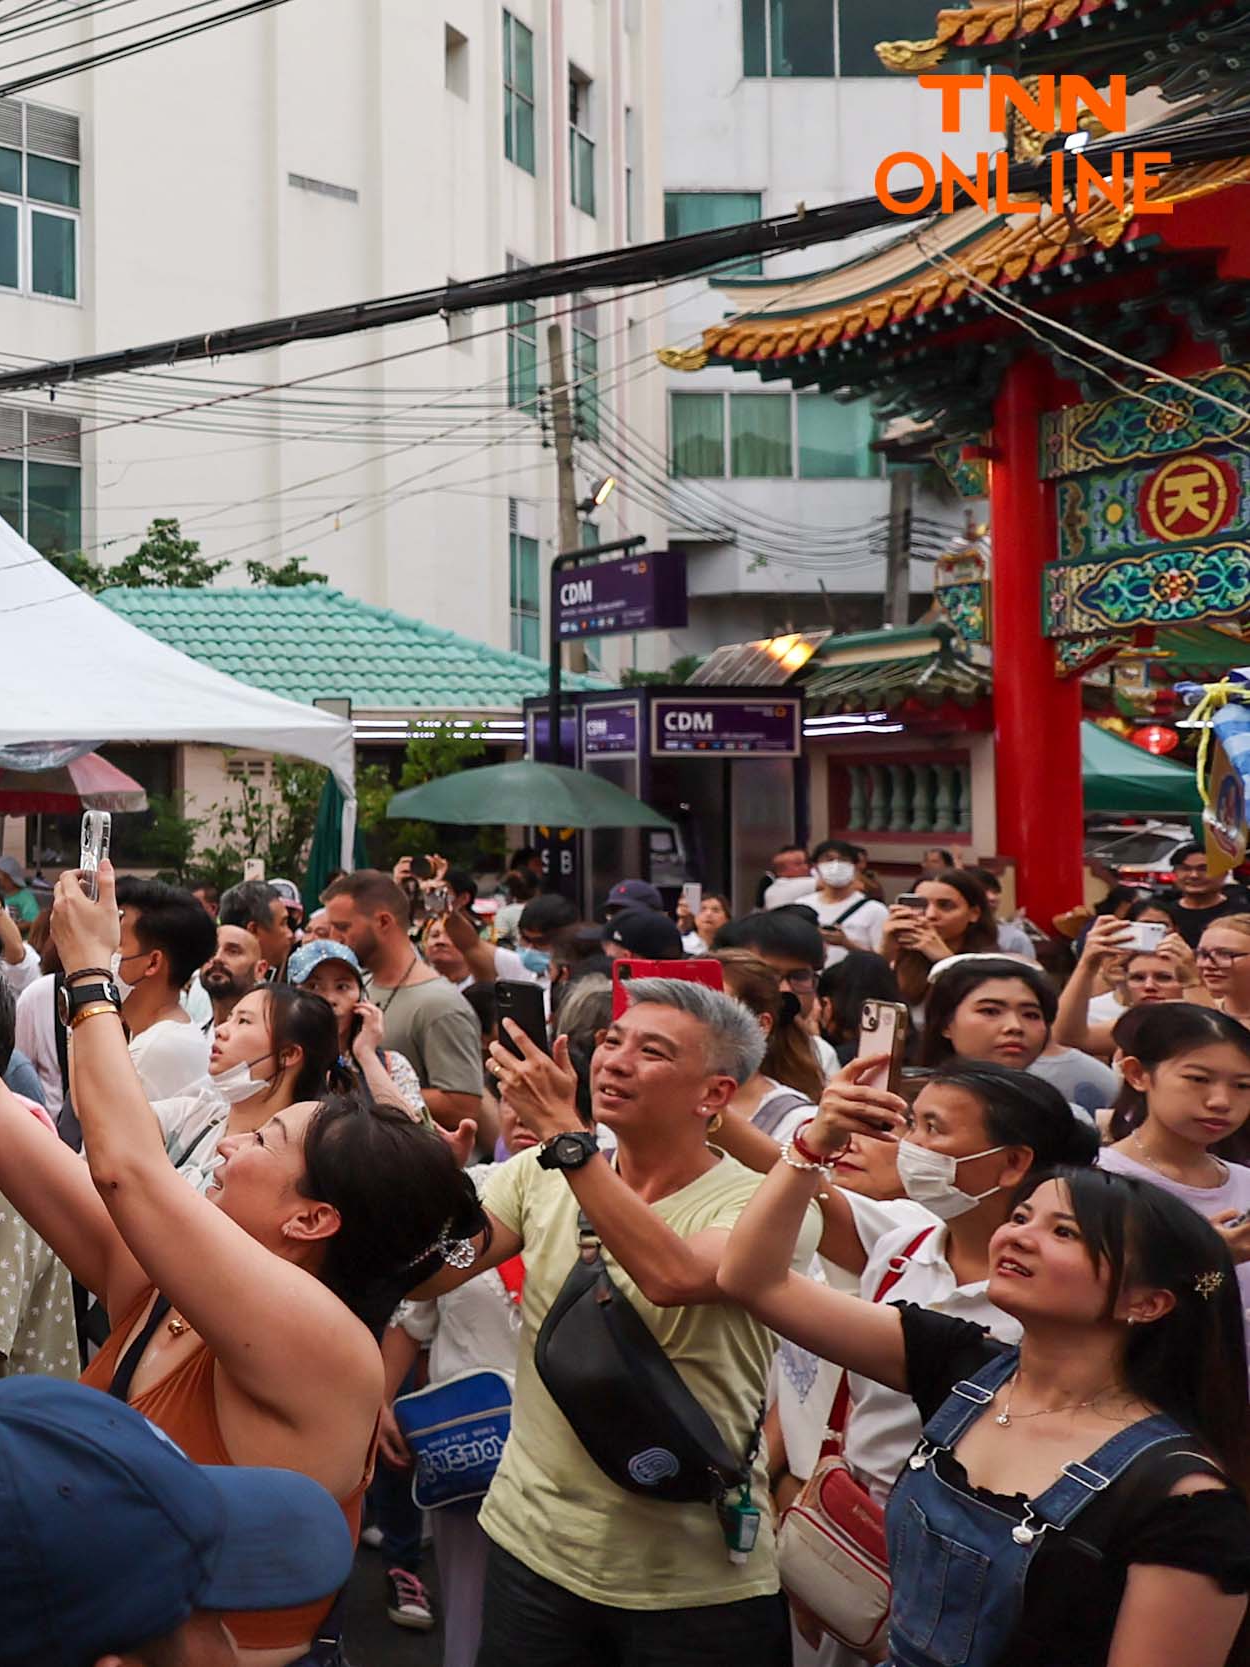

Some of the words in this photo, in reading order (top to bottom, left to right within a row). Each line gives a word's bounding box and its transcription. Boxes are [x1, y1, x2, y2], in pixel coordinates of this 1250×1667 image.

[1163, 471, 1210, 528] 天
[560, 579, 593, 608] CDM
[663, 711, 714, 732] CDM
